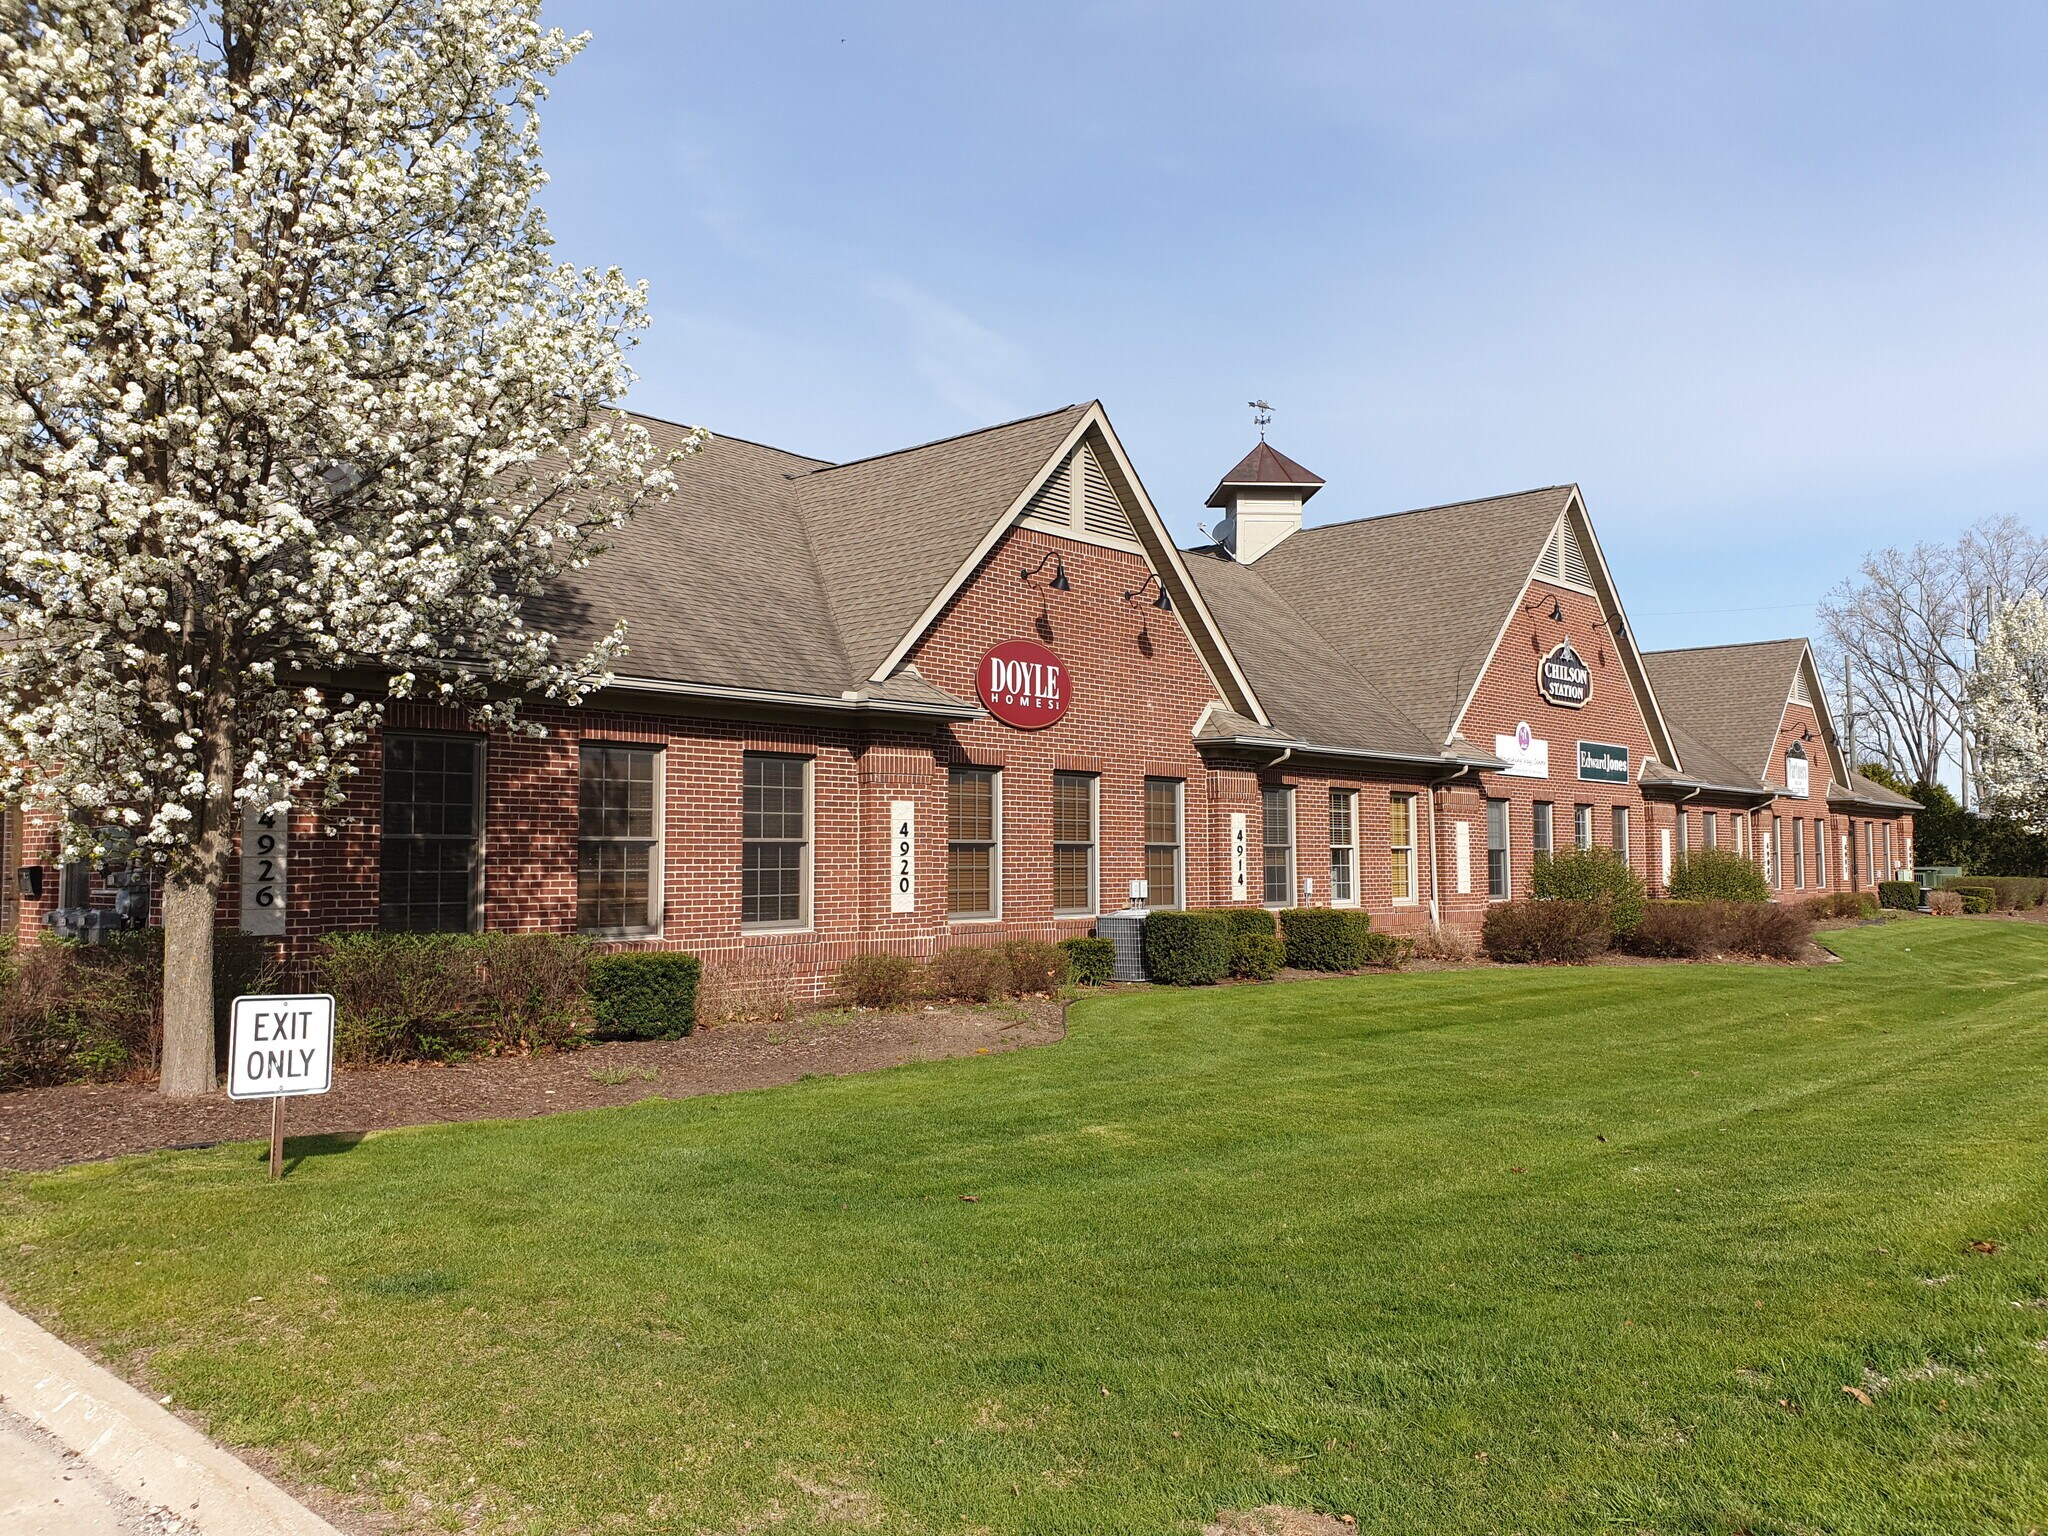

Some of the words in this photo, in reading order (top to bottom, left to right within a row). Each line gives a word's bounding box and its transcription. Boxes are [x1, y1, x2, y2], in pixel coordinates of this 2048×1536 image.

[990, 657, 1060, 700] DOYLE
[1544, 662, 1588, 685] CHILSON
[991, 692, 1054, 710] HOMES
[1549, 681, 1584, 700] STATION
[255, 811, 276, 907] 4926
[898, 822, 910, 893] 4920
[1236, 829, 1244, 886] 4914
[254, 1011, 313, 1042] EXIT
[247, 1048, 316, 1080] ONLY
